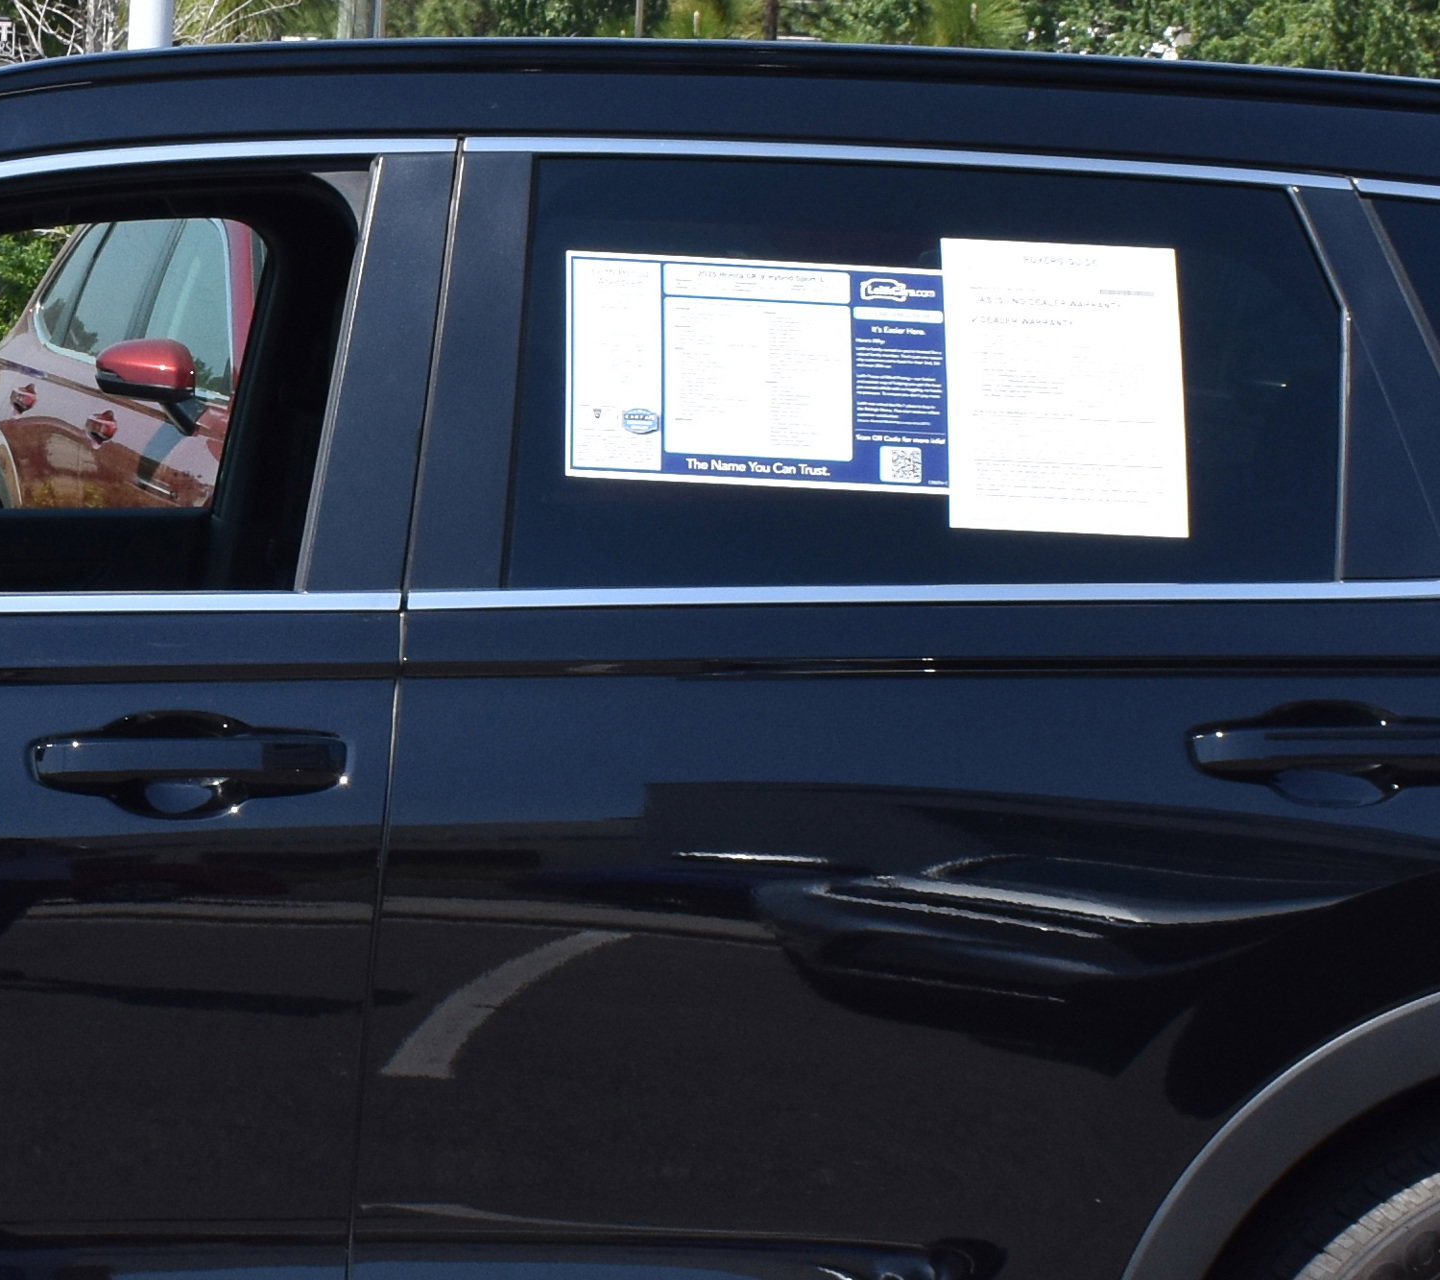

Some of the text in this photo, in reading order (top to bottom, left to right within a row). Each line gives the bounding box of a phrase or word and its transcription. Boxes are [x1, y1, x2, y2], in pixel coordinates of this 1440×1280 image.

[685, 457, 832, 477] The Name You Can Trust.
